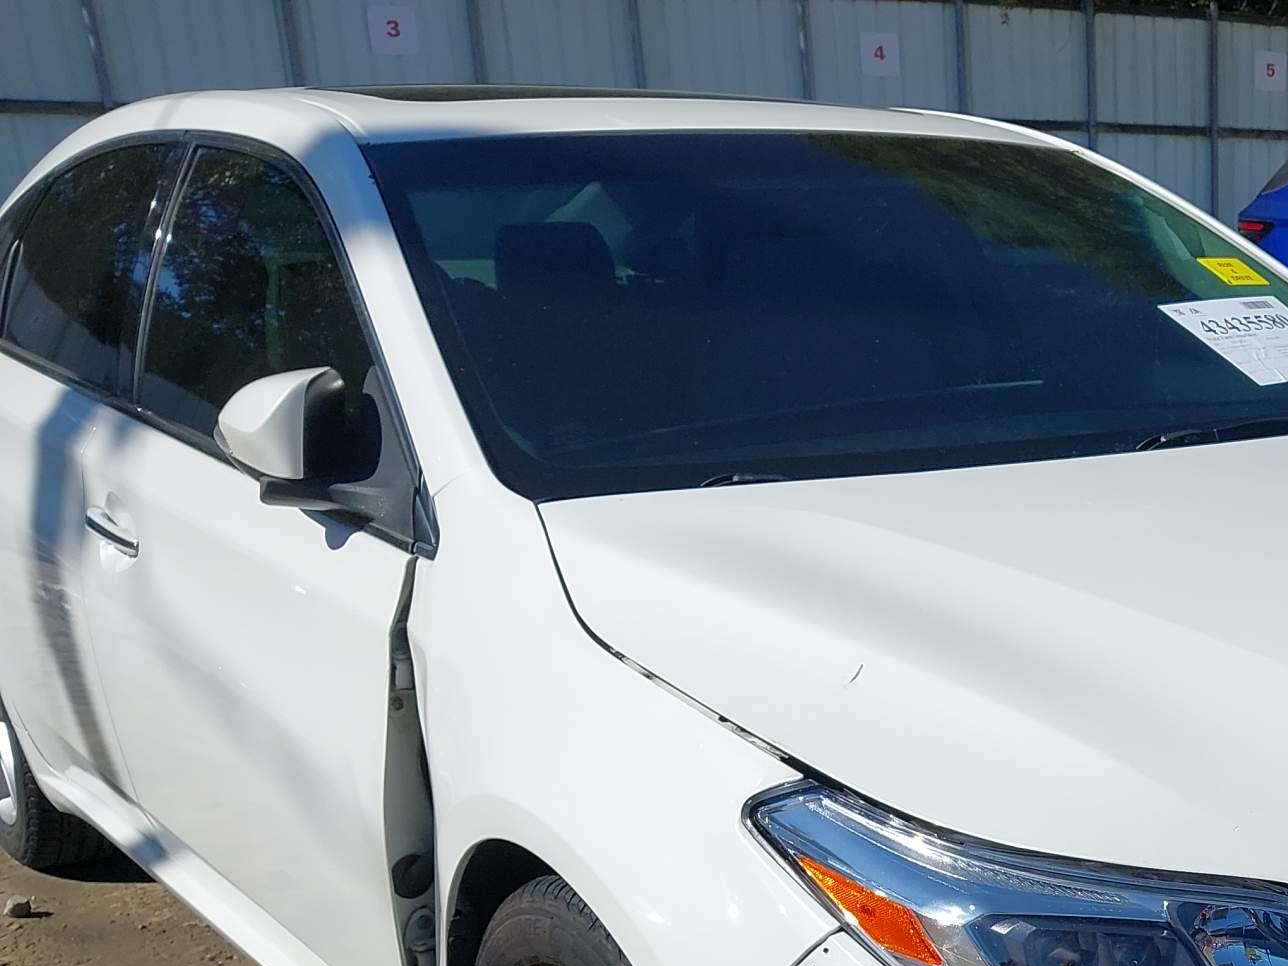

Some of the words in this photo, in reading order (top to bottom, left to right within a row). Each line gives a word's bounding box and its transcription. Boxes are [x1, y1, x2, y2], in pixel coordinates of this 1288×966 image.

[386, 20, 400, 37] 3
[874, 45, 885, 60] 4
[1266, 63, 1275, 78] 5
